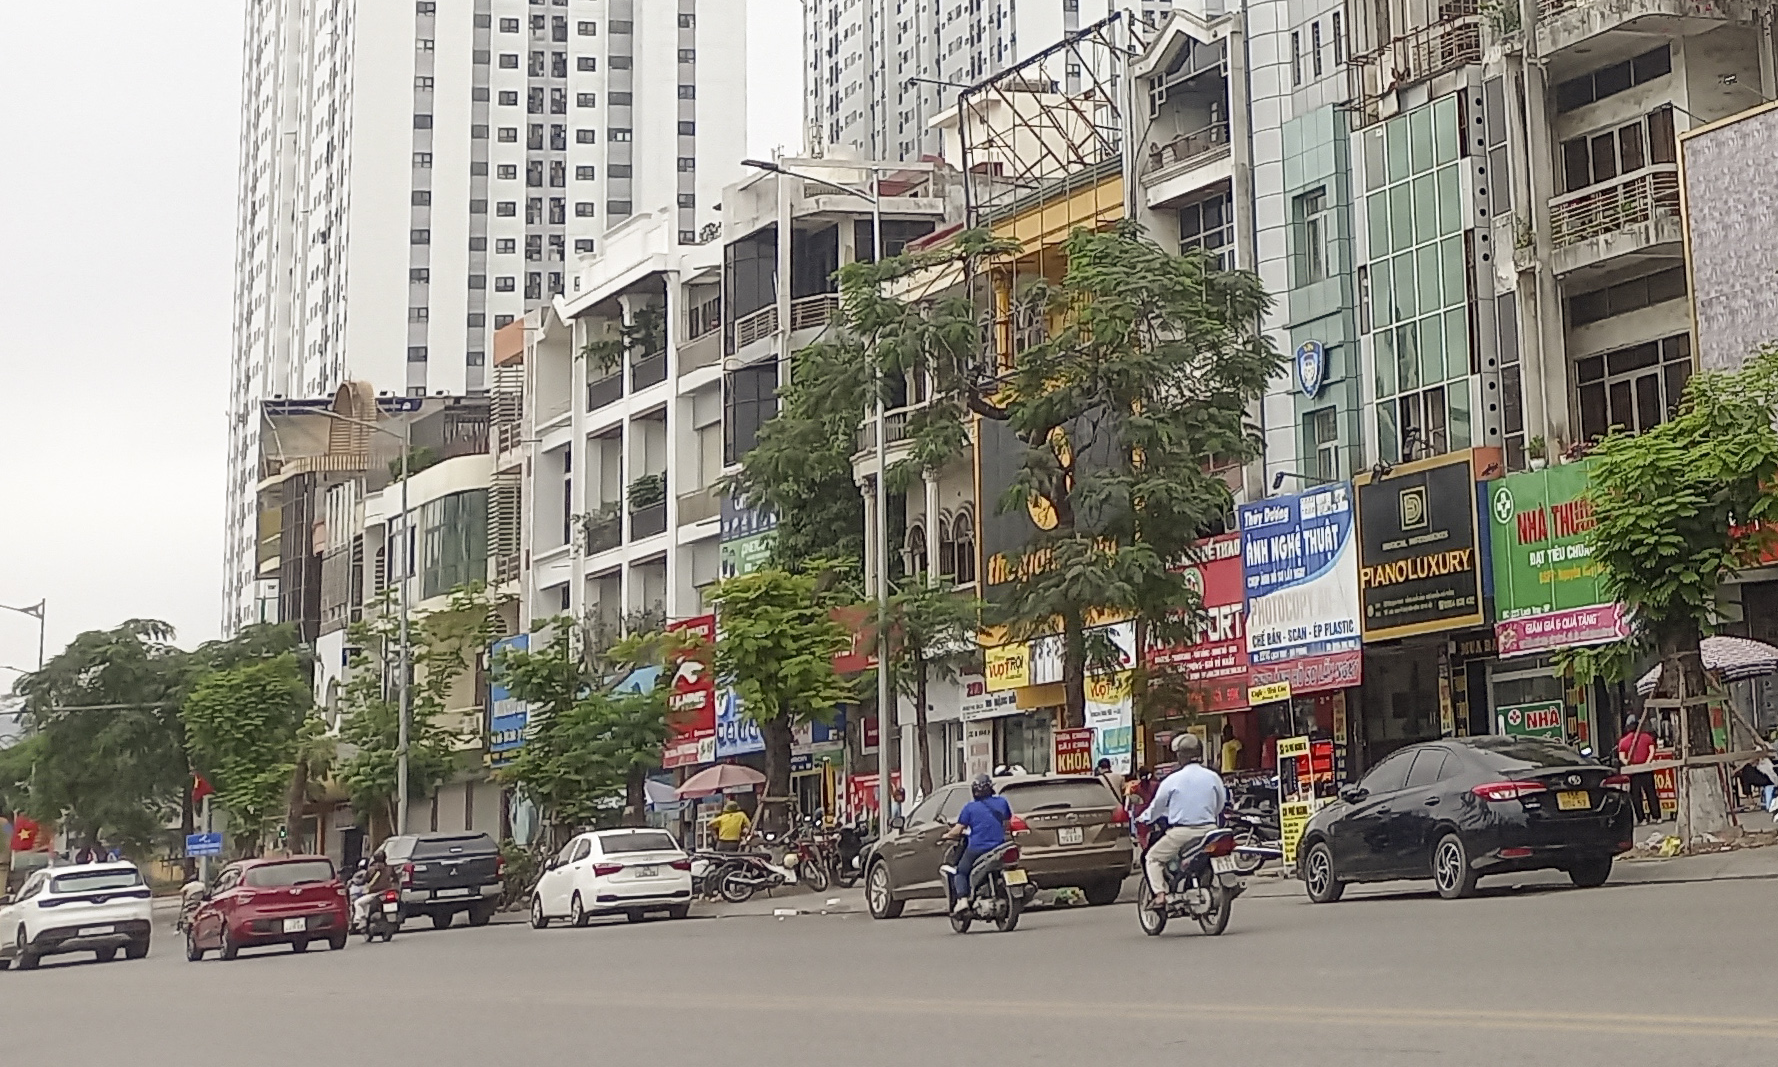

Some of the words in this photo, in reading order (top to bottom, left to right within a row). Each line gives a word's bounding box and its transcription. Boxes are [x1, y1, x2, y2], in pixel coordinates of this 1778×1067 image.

[1516, 502, 1548, 546] NHÀ
[1246, 533, 1269, 568] ẢNH
[1270, 525, 1302, 567] NGHỆ
[1303, 518, 1339, 561] THUẬT
[1548, 543, 1566, 565] TIÊU
[1287, 626, 1307, 643] SCAN
[1324, 618, 1355, 637] PLASTIC
[1525, 705, 1561, 730] NHÀ
[1057, 748, 1091, 773] KHÓA
